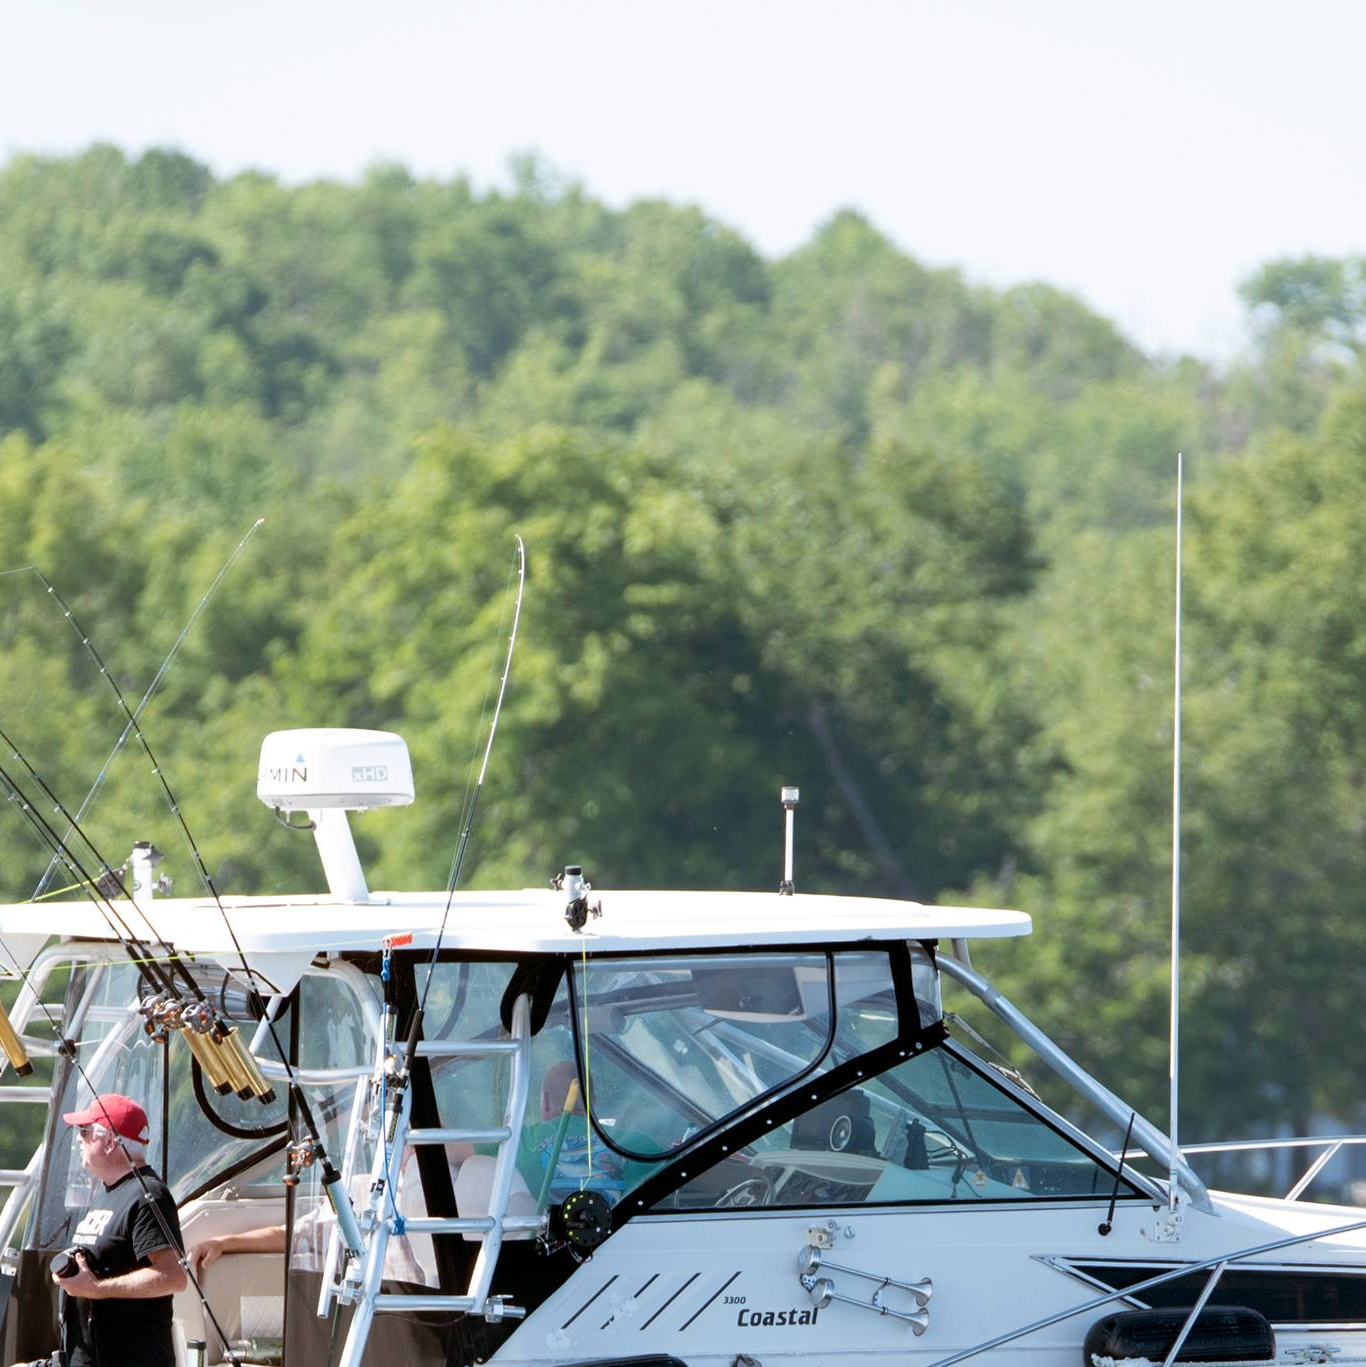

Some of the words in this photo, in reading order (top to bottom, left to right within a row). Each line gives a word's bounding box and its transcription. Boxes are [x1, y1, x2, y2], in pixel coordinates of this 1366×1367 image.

[352, 766, 387, 782] xHD
[723, 1296, 746, 1305] 3300
[737, 1307, 819, 1327] Coastal
